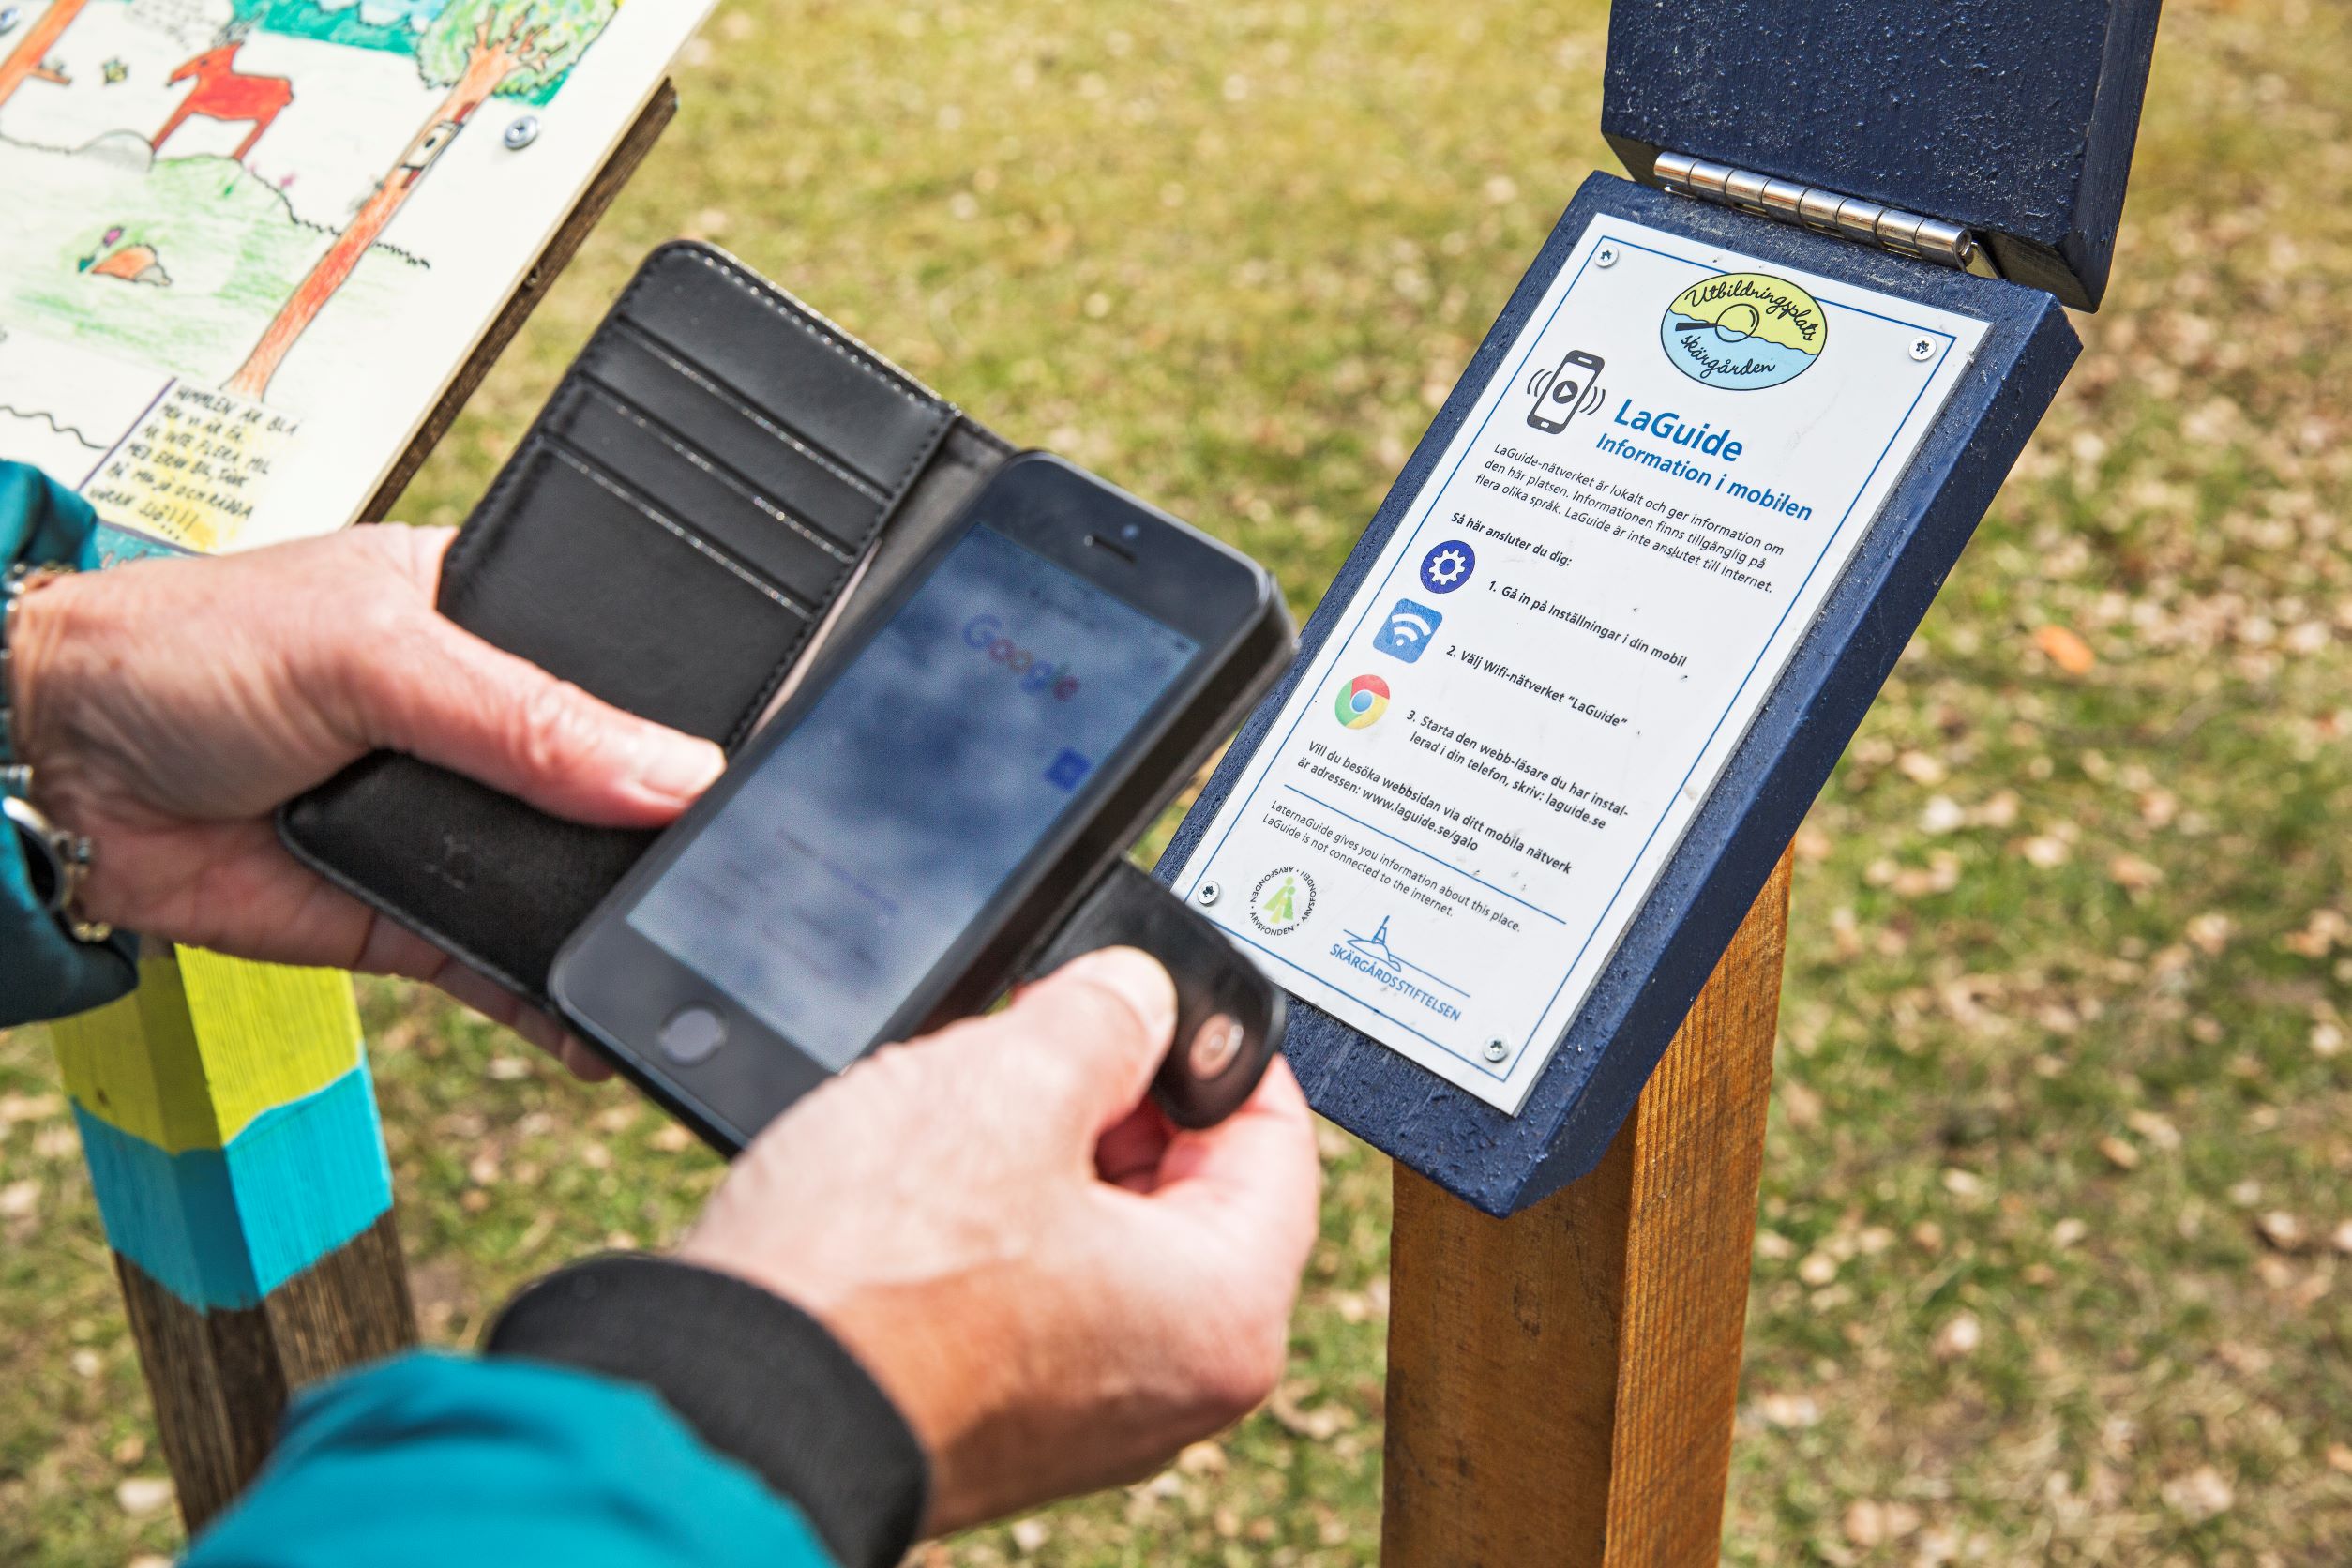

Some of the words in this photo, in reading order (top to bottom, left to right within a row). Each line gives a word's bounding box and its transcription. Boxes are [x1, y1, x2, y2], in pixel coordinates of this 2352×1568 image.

[1681, 335, 1776, 379] skärgården
[1684, 279, 1818, 341] Utbildningsplats
[1595, 432, 1712, 487] Information
[1714, 473, 1728, 490] i
[1726, 481, 1813, 521] mobilen
[1613, 398, 1743, 462] LaGuide
[1450, 512, 1466, 525] Så
[1465, 517, 1486, 533] här
[1485, 527, 1532, 550] ansluter
[1531, 544, 1548, 558] du
[1548, 550, 1573, 567] dig:
[1474, 473, 1500, 491] flera
[1501, 485, 1529, 502] olika
[1529, 496, 1561, 515] språk.
[1564, 506, 1611, 533] LaGuide
[1612, 525, 1627, 537] är
[1626, 530, 1651, 547] inte
[1651, 541, 1702, 566] anslutet
[1702, 558, 1722, 573] till
[1720, 565, 1772, 594] Internet.
[1485, 459, 1506, 475] den
[1506, 465, 1528, 481] här
[1525, 475, 1569, 498] platsen.
[1572, 490, 1654, 529] Informationen
[1655, 520, 1686, 540] finns
[1686, 533, 1748, 565] tillgänglig
[1747, 557, 1767, 569] på
[1493, 443, 1595, 488] LaGuide-nätverket
[1595, 480, 1610, 492] är
[1609, 484, 1644, 505] lokalt
[1645, 500, 1666, 514] och
[1666, 508, 1690, 521] ger
[1690, 513, 1762, 548] information
[1763, 542, 1785, 556] om
[1488, 580, 1497, 593] 1.
[1501, 585, 1519, 600] Gå
[1517, 592, 1530, 606] in
[1530, 599, 1548, 612] på
[1547, 604, 1622, 641] Inställningar
[1621, 633, 1630, 644] i
[1628, 638, 1650, 653] din
[1650, 647, 1688, 668] mobil
[1445, 644, 1456, 658] 2.
[1460, 650, 1484, 670] Välj
[1483, 659, 1565, 703] Wifi-nätverket
[1297, 756, 1311, 770] är
[1310, 764, 1362, 794] adressen:
[1362, 789, 1479, 852] www.laguide.se/galo
[1308, 740, 1328, 757] Vill
[1326, 750, 1342, 764] du
[1342, 756, 1380, 783] besöka
[1381, 777, 1441, 812] webbsidan
[1443, 807, 1461, 822] via
[1461, 815, 1485, 833] ditt
[1484, 826, 1525, 852] mobila
[1525, 846, 1573, 875] nätverk
[1406, 709, 1416, 723] 3.
[1419, 716, 1455, 739] Starta
[1455, 732, 1478, 750] den
[1479, 744, 1549, 782] webb-läsare
[1550, 776, 1568, 791] du
[1568, 781, 1591, 800] har
[1590, 792, 1628, 816] instal-
[1410, 731, 1441, 753] lerad
[1440, 745, 1448, 756] i
[1446, 749, 1466, 765] din
[1467, 758, 1509, 787] telefon,
[1512, 780, 1545, 801] skriv:
[1545, 792, 1606, 830] laguide.se
[1262, 813, 1301, 839] LaGuide
[1301, 832, 1311, 844] is
[1310, 839, 1329, 853] not
[1329, 849, 1381, 879] connected
[1380, 872, 1392, 884] to
[1393, 879, 1410, 895] the
[1410, 887, 1453, 917] internet.
[1271, 800, 1334, 838] LaternaGuide
[1332, 834, 1360, 851] gives
[1357, 846, 1379, 861] you
[1379, 853, 1438, 890] information
[1439, 885, 1470, 907] about
[1470, 900, 1491, 916] this
[1489, 912, 1520, 932] place.
[1329, 943, 1461, 1021] SKÄRGÅRDSSTIFTELSEN
